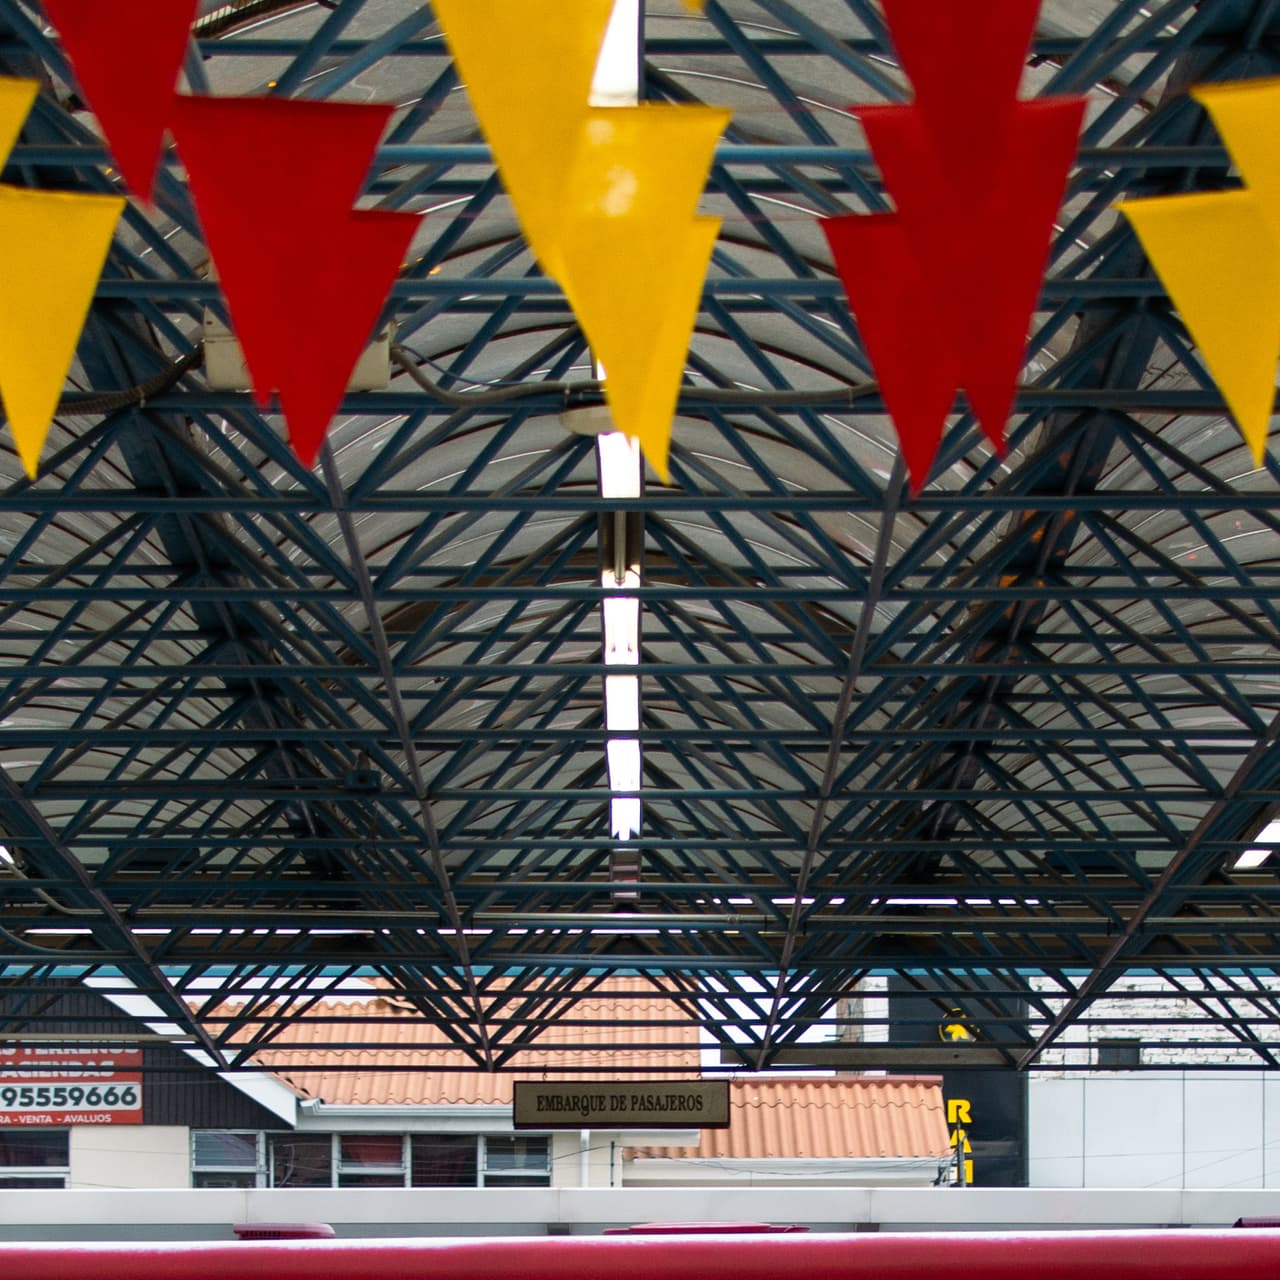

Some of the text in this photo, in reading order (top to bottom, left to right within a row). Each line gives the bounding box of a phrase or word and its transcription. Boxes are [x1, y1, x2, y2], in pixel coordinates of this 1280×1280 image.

[536, 1094, 703, 1116] EMBARQUE DE PASAJEROS
[20, 1115, 53, 1124] VENTA
[64, 1114, 112, 1123] AVALUOS
